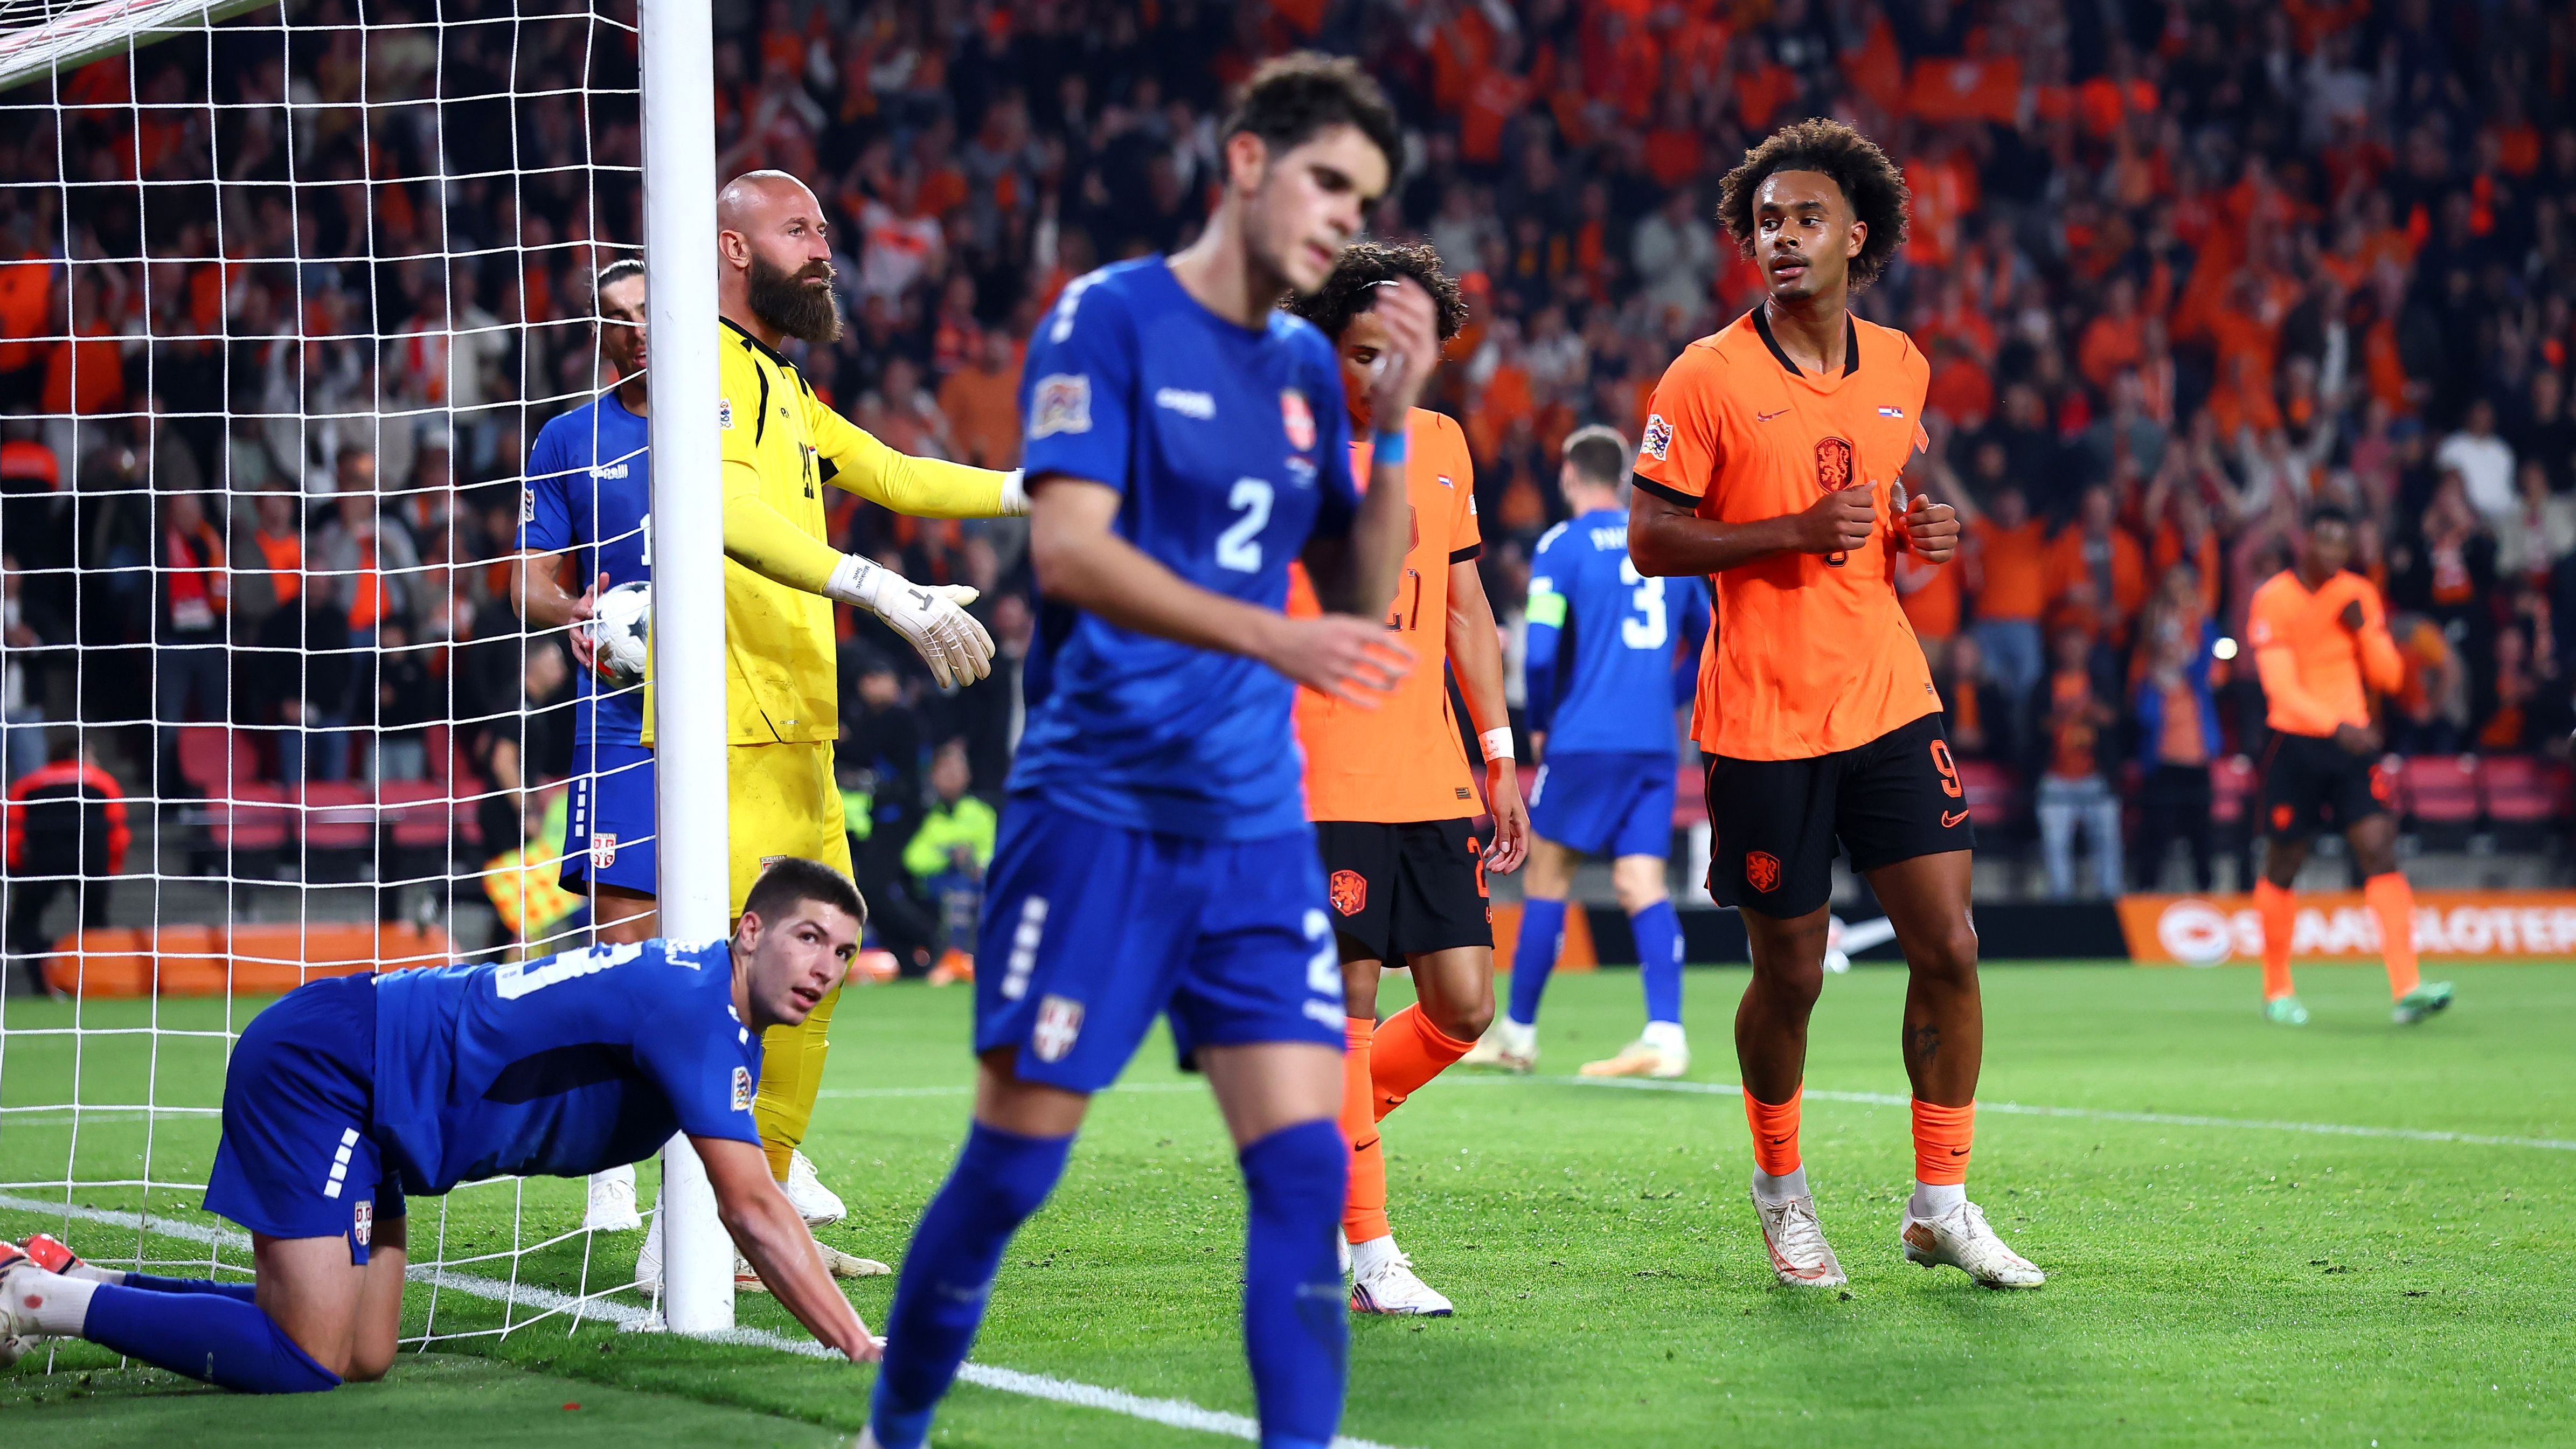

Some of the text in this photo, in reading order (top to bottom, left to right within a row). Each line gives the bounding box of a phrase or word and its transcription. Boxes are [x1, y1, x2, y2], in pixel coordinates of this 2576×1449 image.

[1216, 476, 1275, 573] 2
[1619, 554, 1668, 650] 3
[1930, 739, 1962, 798] 9
[1302, 908, 1342, 998] 2
